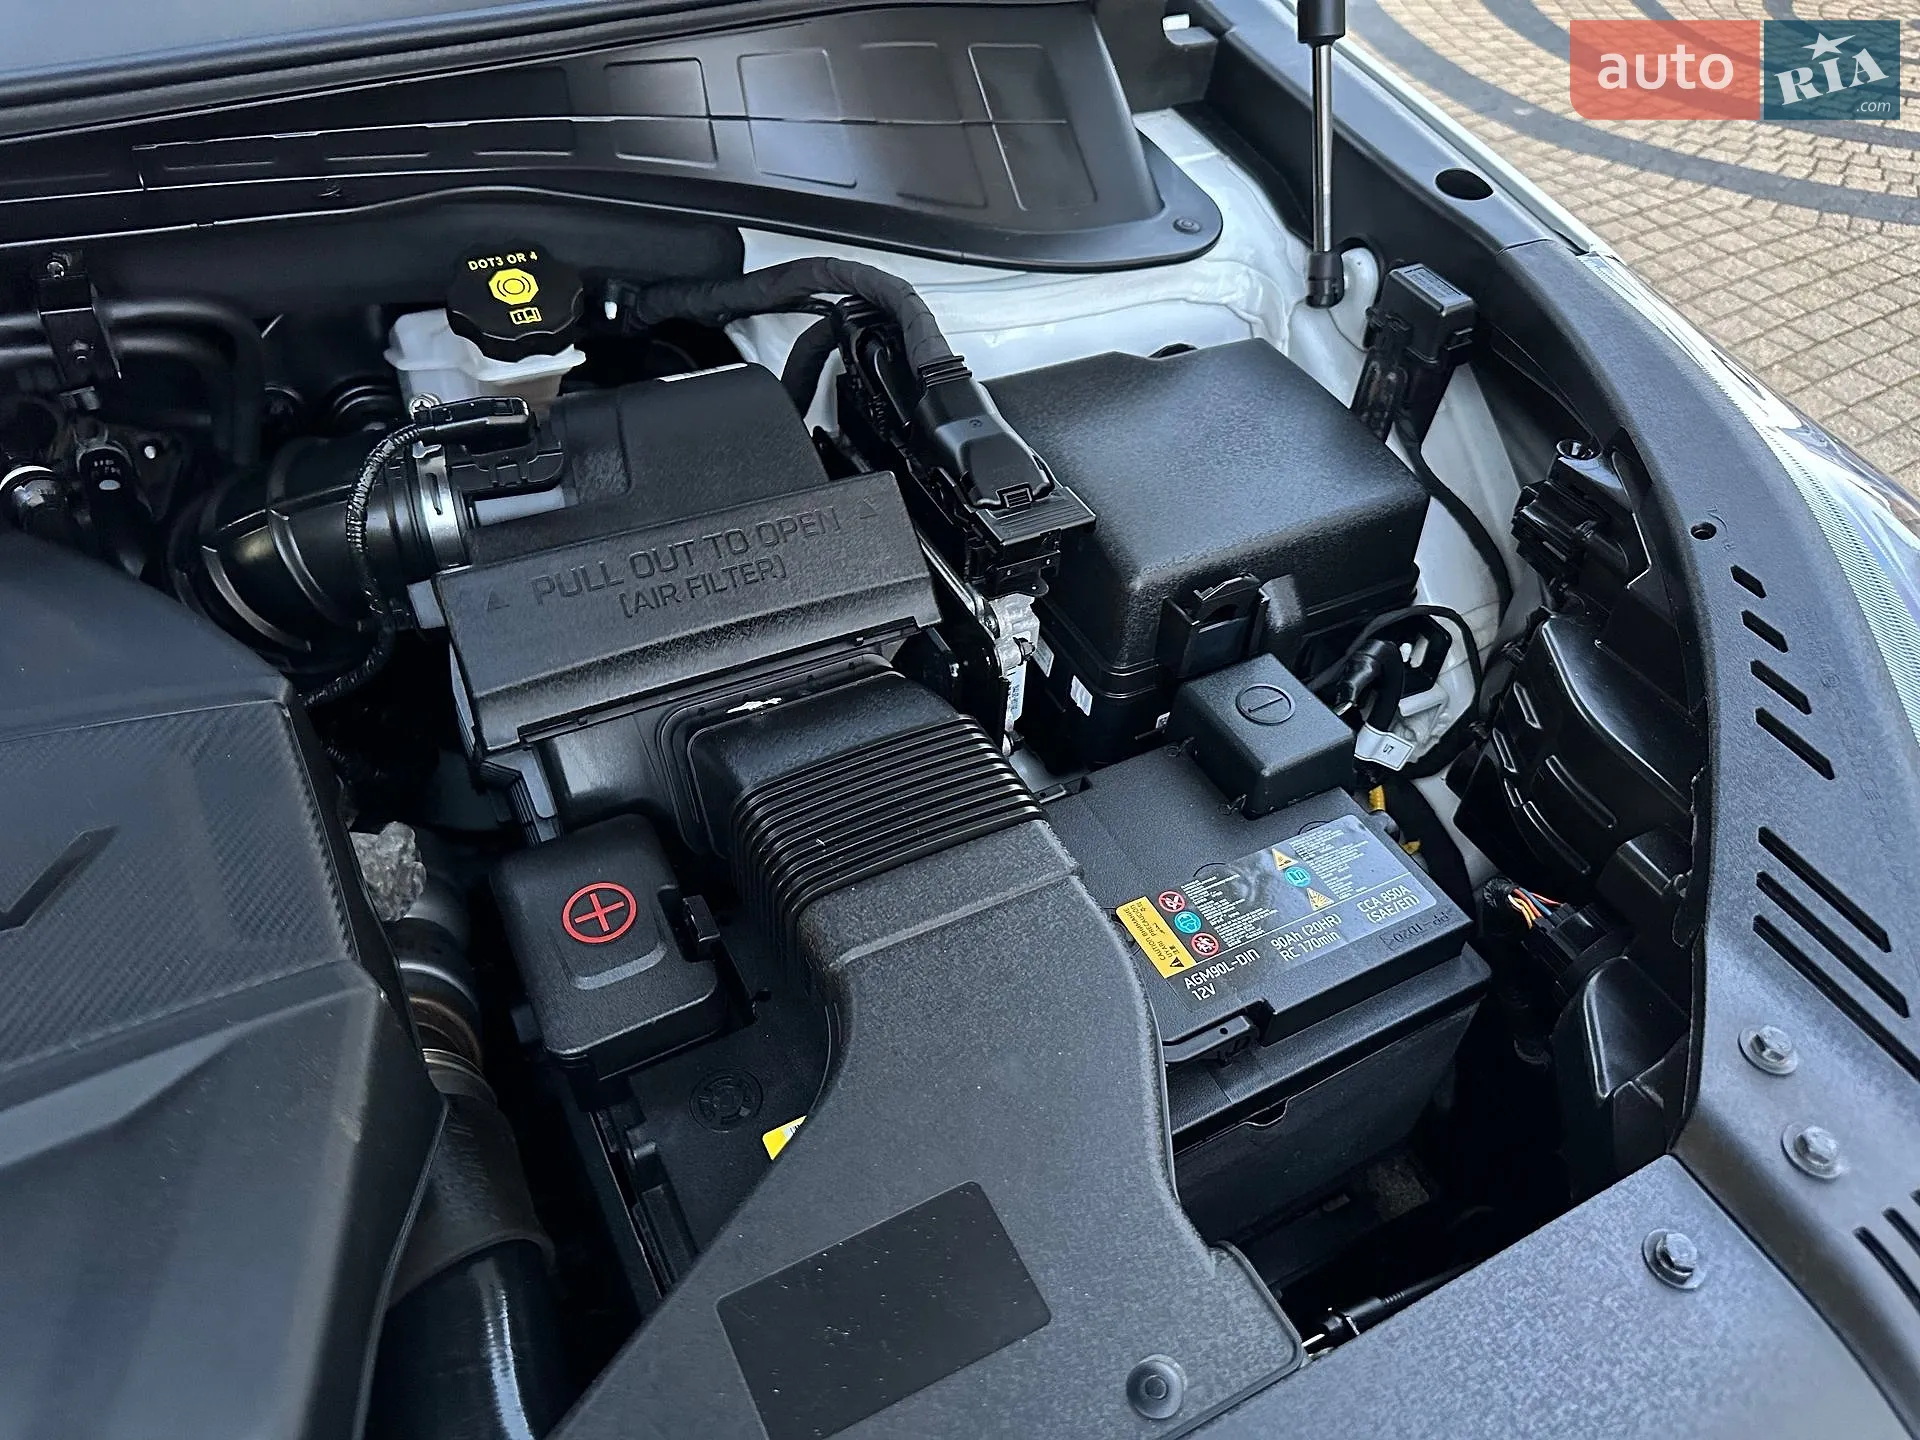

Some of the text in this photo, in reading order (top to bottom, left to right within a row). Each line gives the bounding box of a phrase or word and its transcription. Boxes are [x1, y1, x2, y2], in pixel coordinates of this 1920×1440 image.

[467, 251, 538, 271] DOT3 OR 4
[531, 506, 841, 605] PULL OUT TO OPEN
[1357, 885, 1412, 912] CCA 850A
[1271, 913, 1342, 950] 90Ah (20HR)
[1279, 931, 1341, 961] RC 170min
[1191, 982, 1216, 1001] 12V
